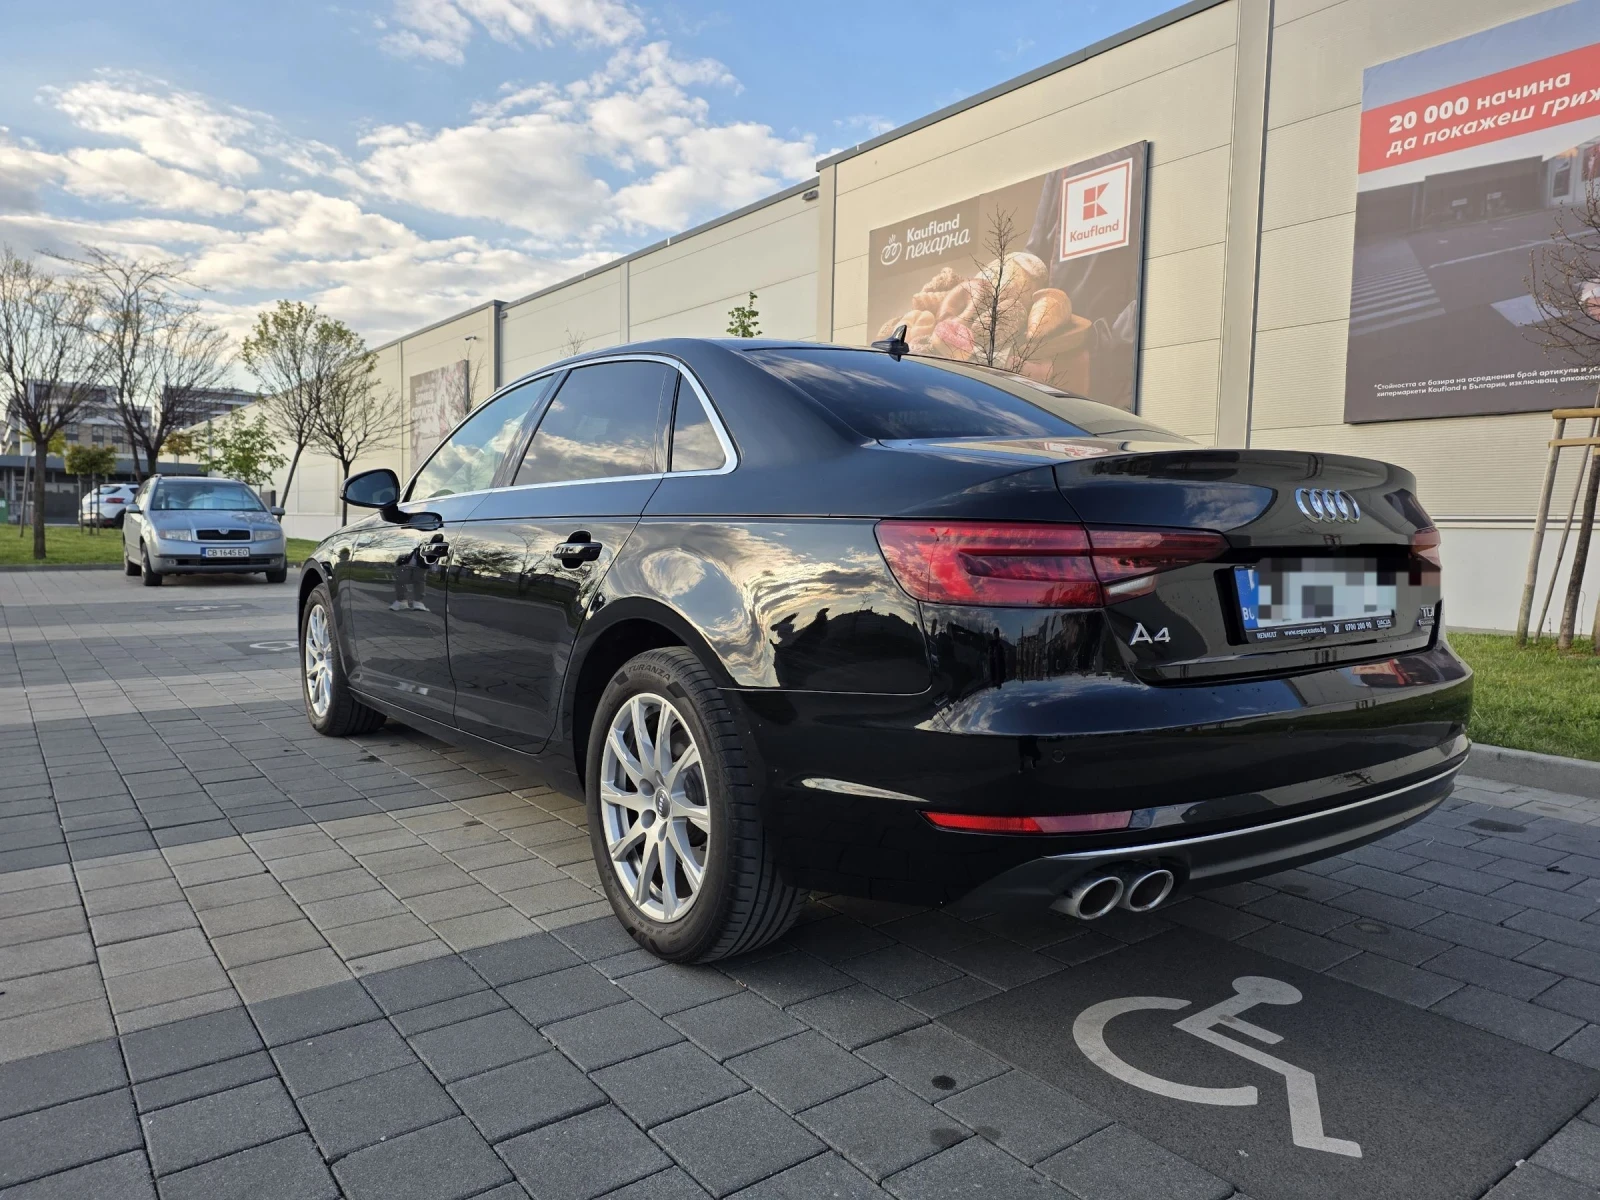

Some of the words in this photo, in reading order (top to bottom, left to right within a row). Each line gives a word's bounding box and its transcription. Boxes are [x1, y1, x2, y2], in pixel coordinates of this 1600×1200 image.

[1388, 111, 1418, 134] 20
[1423, 96, 1470, 124] 000
[1476, 72, 1571, 111] начина
[1386, 136, 1417, 158] да
[1422, 105, 1535, 146] покажеш
[906, 213, 960, 243] Kaufland
[1069, 219, 1120, 243] Kaufland
[905, 228, 971, 261] пекарна
[1516, 370, 1538, 379] брой
[1376, 388, 1427, 398] хипермаркети
[1428, 384, 1461, 393] Kaufland
[207, 549, 218, 557] CB
[219, 549, 237, 557] 1645
[1420, 606, 1435, 618] TDI
[1130, 622, 1171, 646] A4
[1256, 631, 1277, 639] RENAULT
[1344, 622, 1357, 631] 0700
[628, 664, 671, 682] TURANZA
